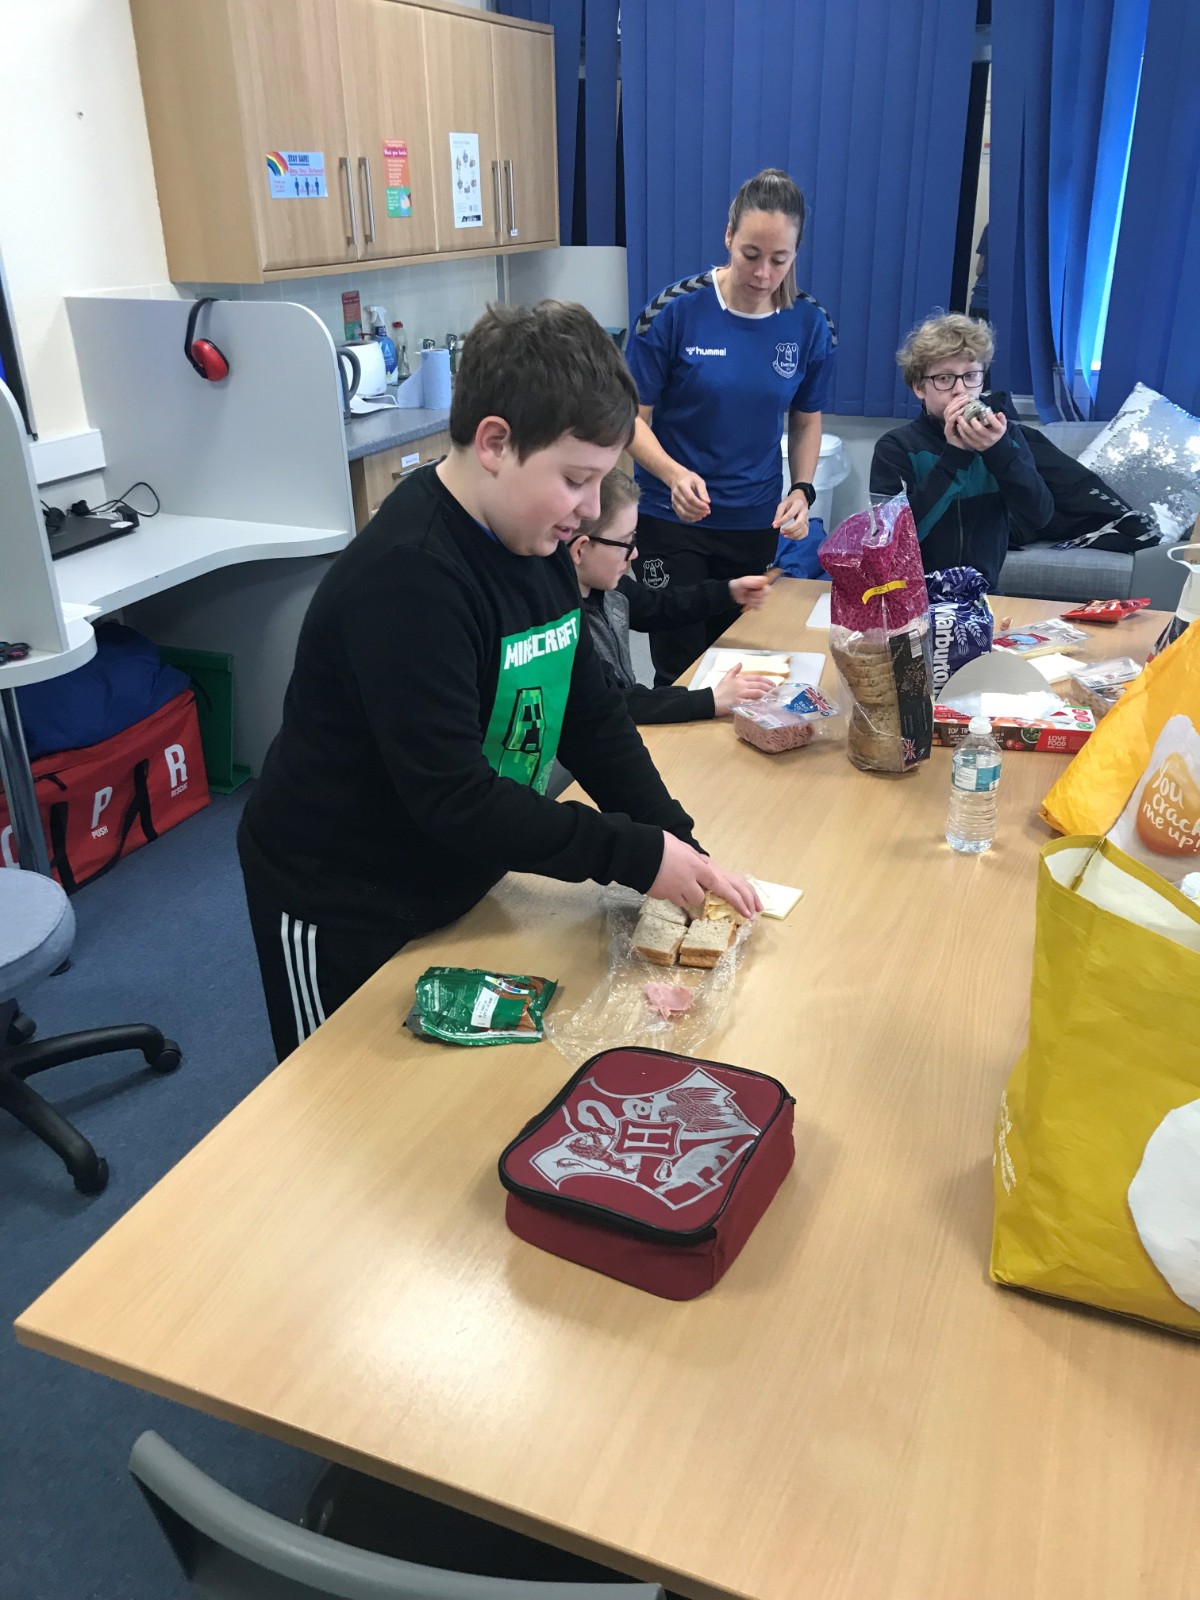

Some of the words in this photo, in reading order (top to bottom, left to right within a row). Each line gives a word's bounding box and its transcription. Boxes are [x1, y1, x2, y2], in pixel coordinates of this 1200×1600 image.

[288, 154, 298, 163] STAY
[695, 346, 727, 356] hummel
[933, 602, 959, 701] Warburton
[948, 727, 960, 735] TOP
[91, 786, 113, 829] P
[164, 743, 188, 789] R
[1152, 760, 1185, 810] You
[91, 825, 109, 840] PUSH
[170, 782, 188, 798] RESCUE
[1142, 801, 1165, 829] me
[623, 1125, 673, 1150] H
